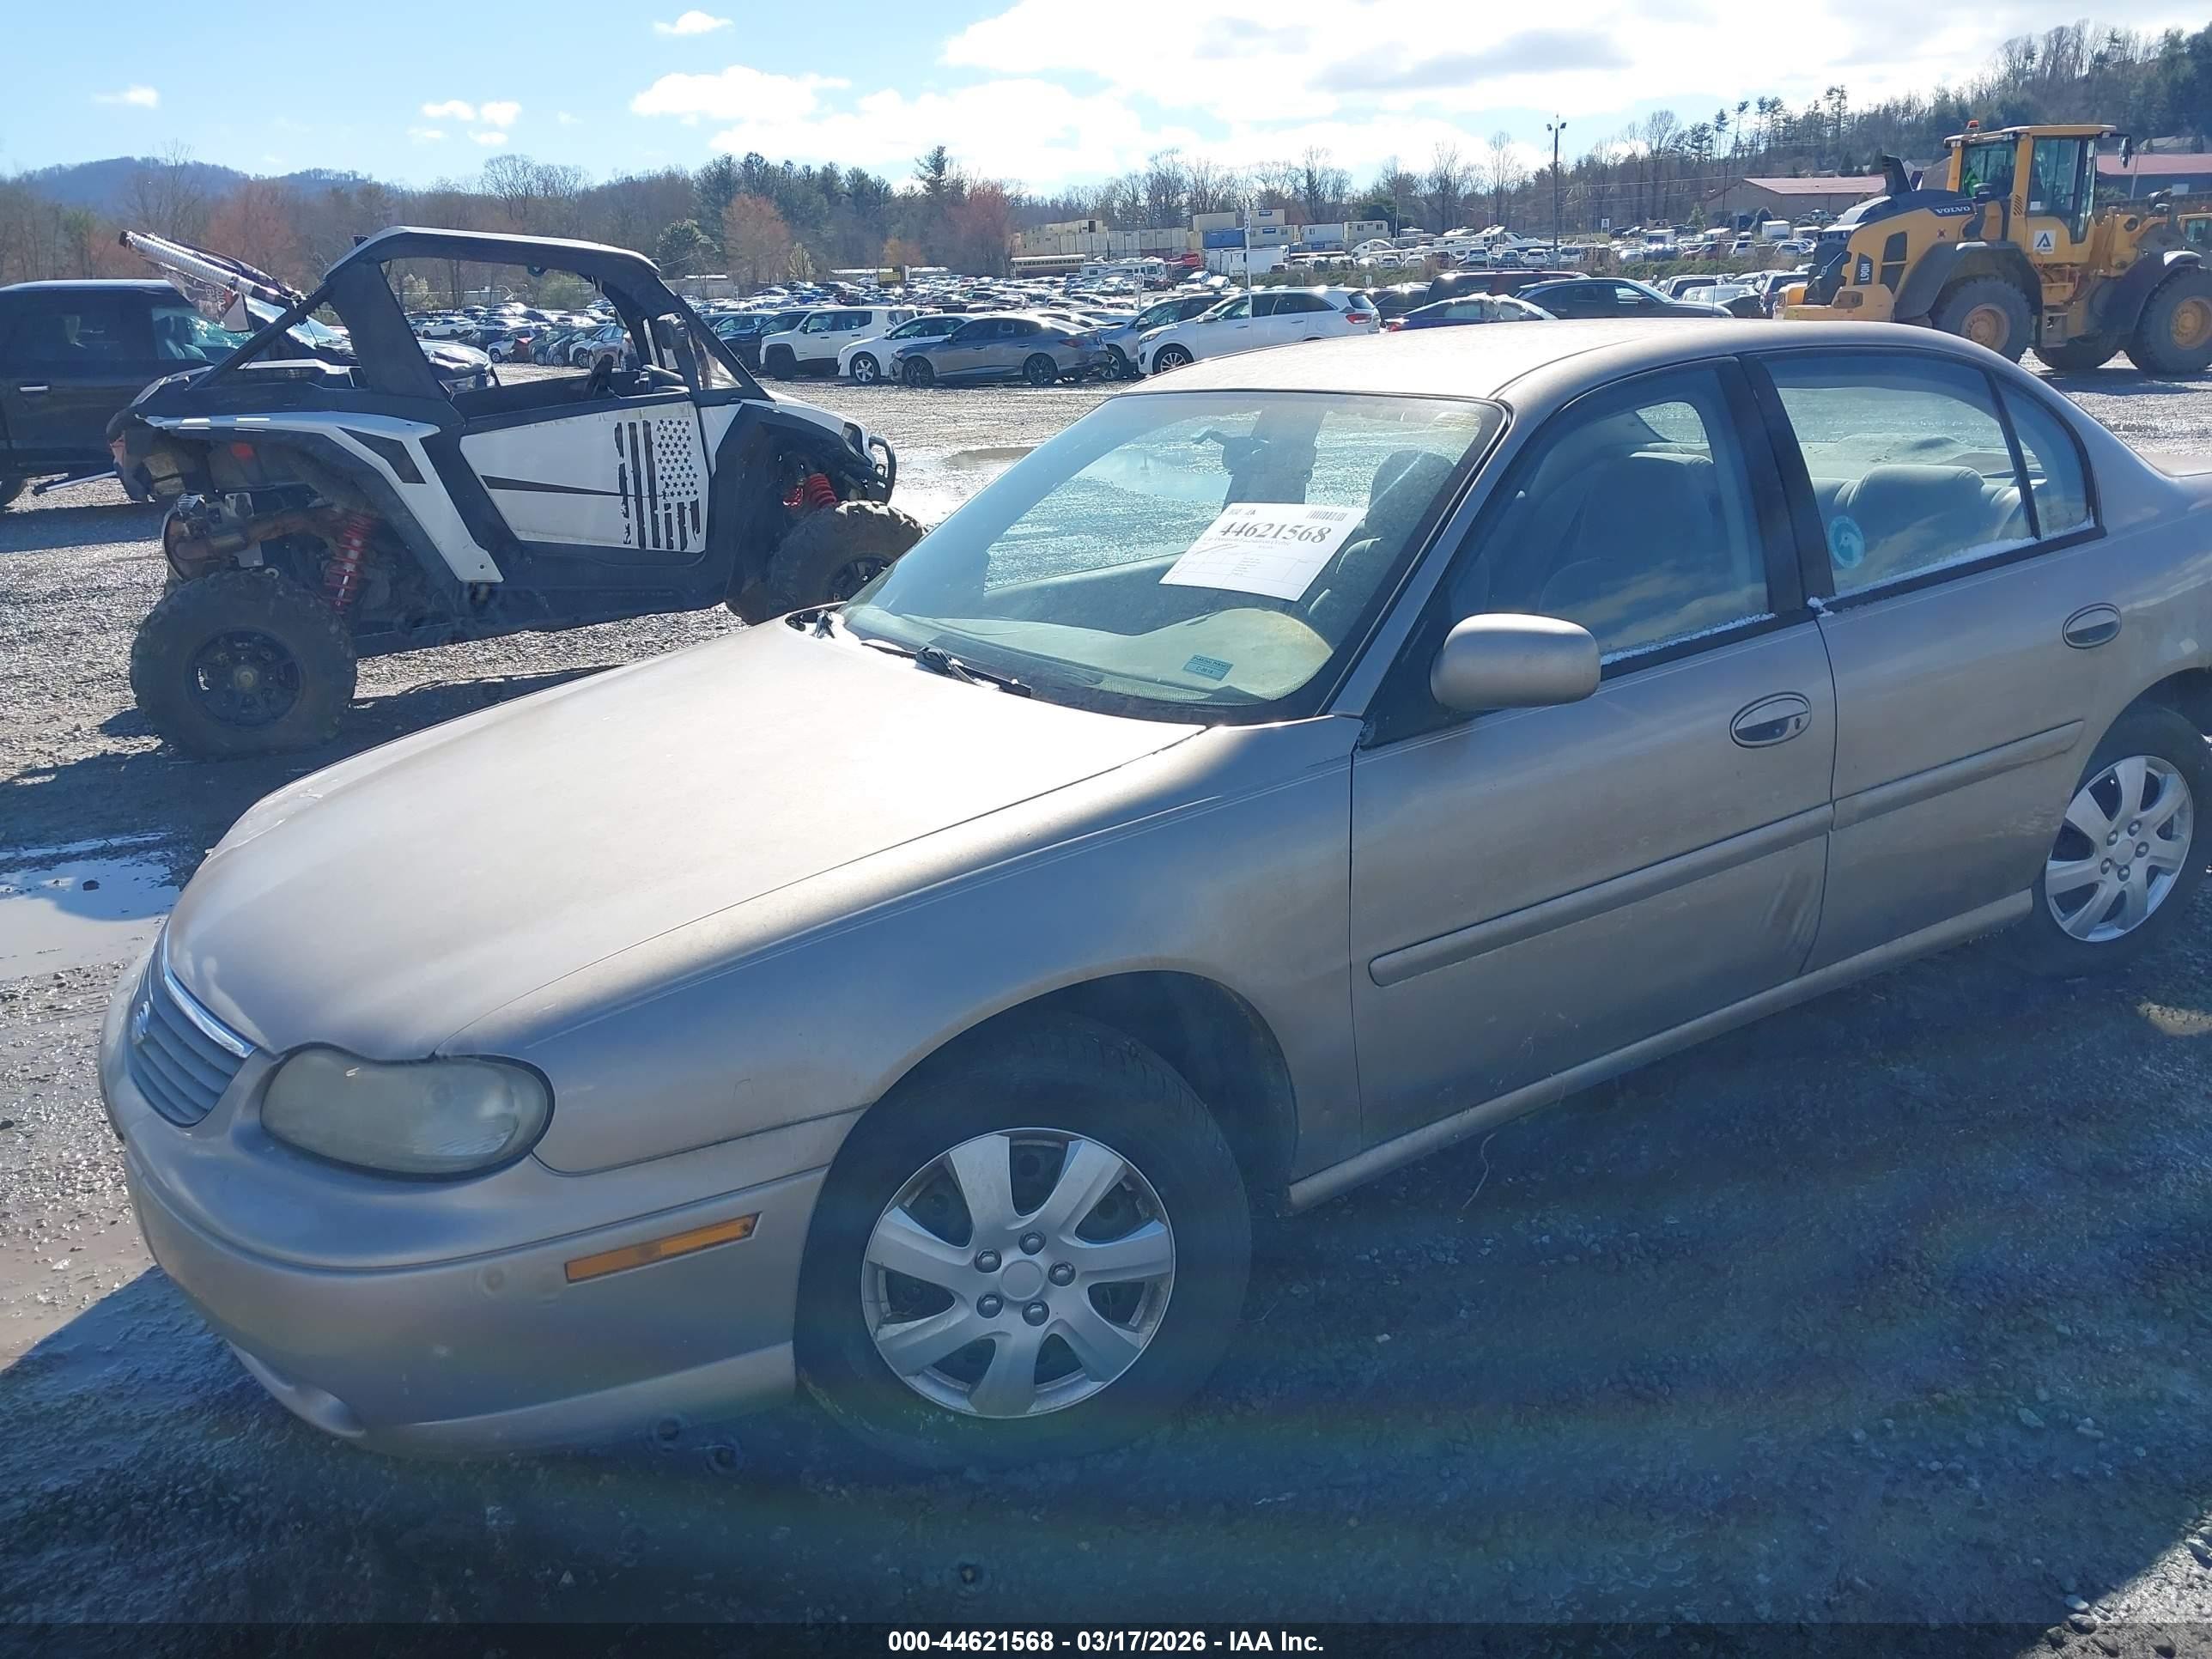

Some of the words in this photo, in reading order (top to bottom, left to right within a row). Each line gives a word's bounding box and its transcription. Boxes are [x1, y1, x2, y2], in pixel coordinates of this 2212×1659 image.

[1935, 205, 1972, 214] VOLVO
[1860, 263, 1870, 282] L90H
[1133, 275, 1143, 285] 50
[1219, 521, 1332, 544] 44621568
